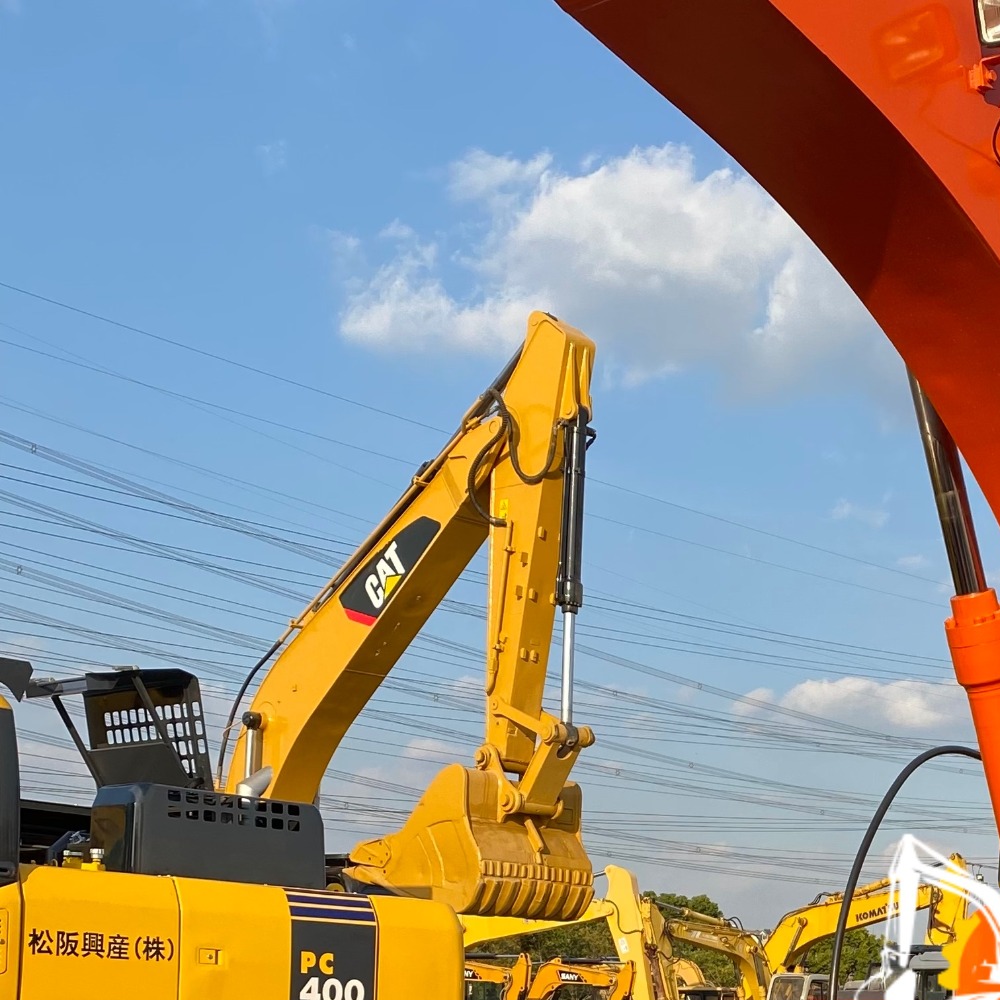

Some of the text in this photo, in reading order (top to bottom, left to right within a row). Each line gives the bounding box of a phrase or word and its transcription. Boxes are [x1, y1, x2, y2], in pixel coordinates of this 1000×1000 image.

[365, 541, 406, 609] CAT
[855, 901, 899, 922] KOMATU
[300, 950, 334, 975] PC
[560, 973, 579, 981] SANY
